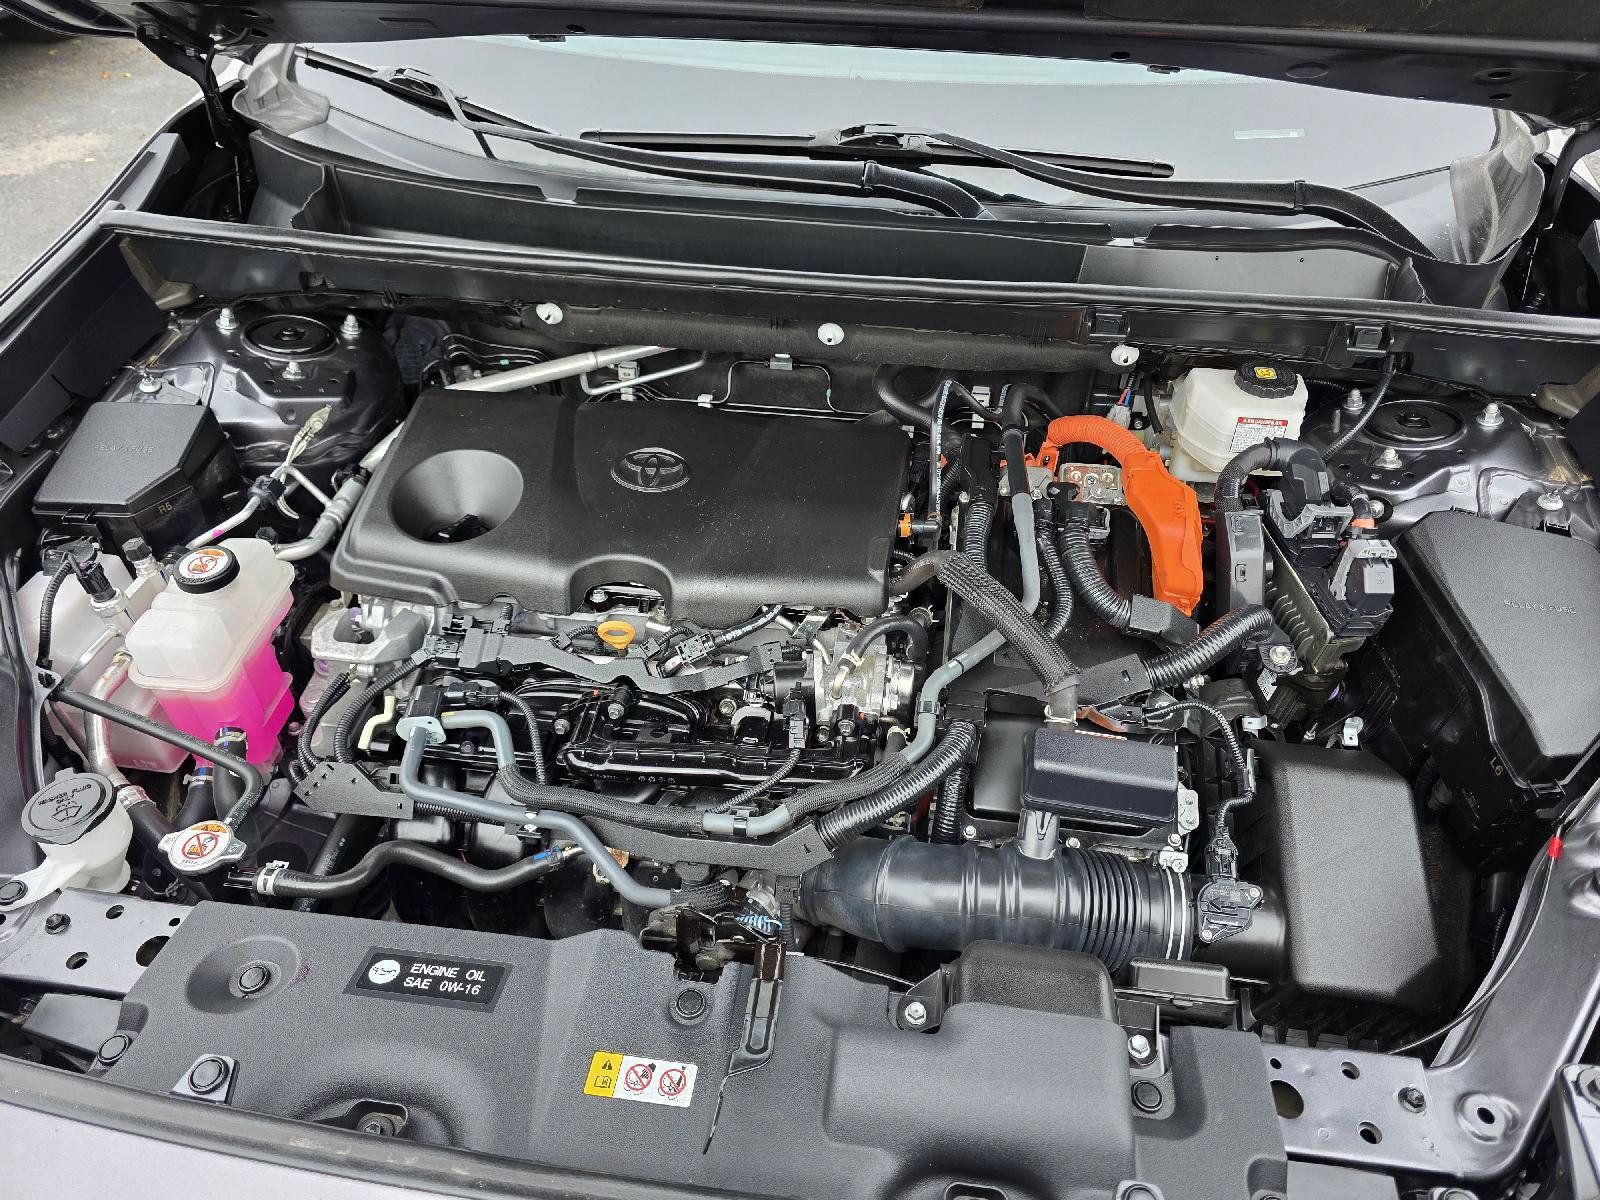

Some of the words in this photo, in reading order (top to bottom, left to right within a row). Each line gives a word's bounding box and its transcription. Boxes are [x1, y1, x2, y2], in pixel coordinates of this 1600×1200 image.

[158, 501, 173, 515] R6
[38, 791, 69, 806] WASHER
[410, 963, 460, 978] ENGINE
[465, 969, 486, 982] OIL
[403, 976, 433, 990] SAE
[439, 980, 482, 995] 0W-16
